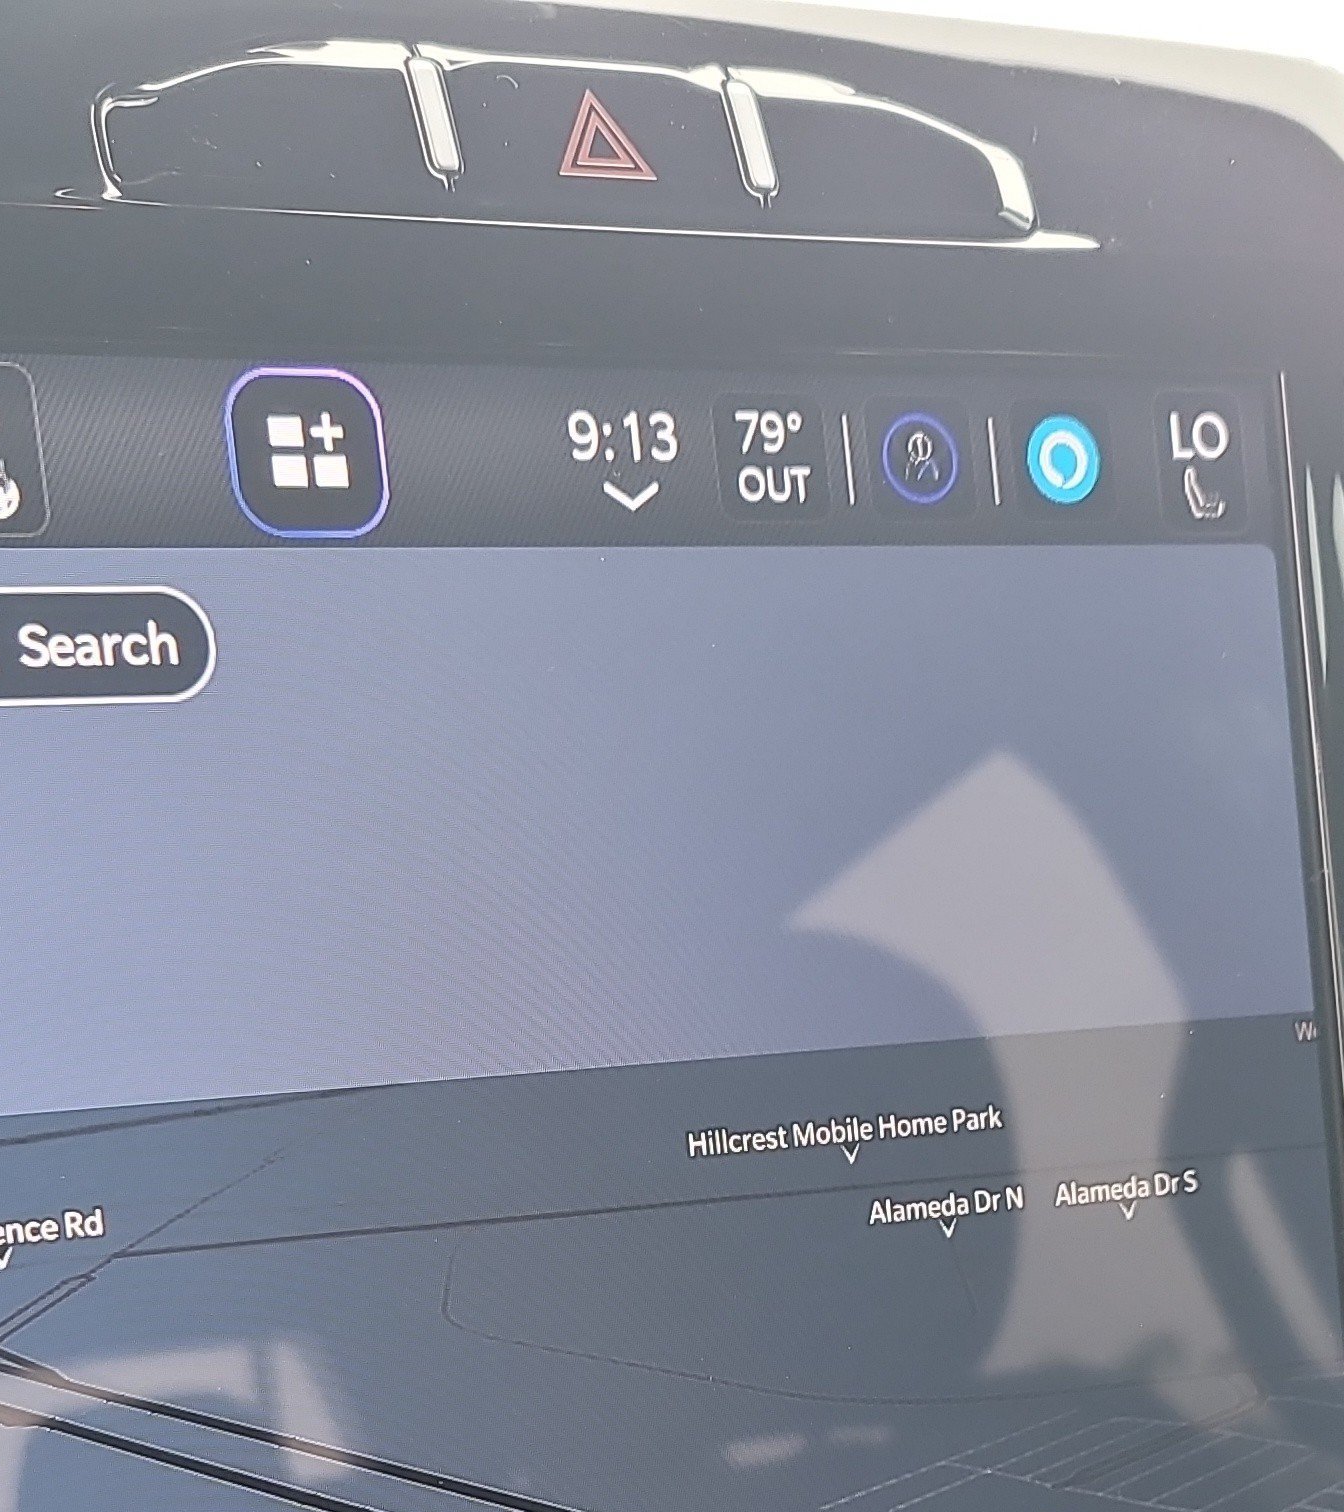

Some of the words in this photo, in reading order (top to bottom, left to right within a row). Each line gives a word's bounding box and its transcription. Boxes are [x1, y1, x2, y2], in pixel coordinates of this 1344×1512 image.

[567, 409, 679, 463] 9:13
[1170, 410, 1229, 461] LO
[738, 466, 812, 504] OUT
[18, 620, 180, 670] Search
[687, 1127, 789, 1158] Hillcrest
[792, 1116, 874, 1147] Mobile
[877, 1110, 948, 1141] Home
[952, 1105, 1003, 1132] Park
[869, 1192, 969, 1225] Alameda
[974, 1191, 1001, 1215] Dr
[1005, 1186, 1025, 1209] N
[1054, 1173, 1150, 1207] Alameda
[1154, 1173, 1181, 1195] Dr
[1183, 1168, 1199, 1193] S
[62, 1206, 105, 1240] Rd
